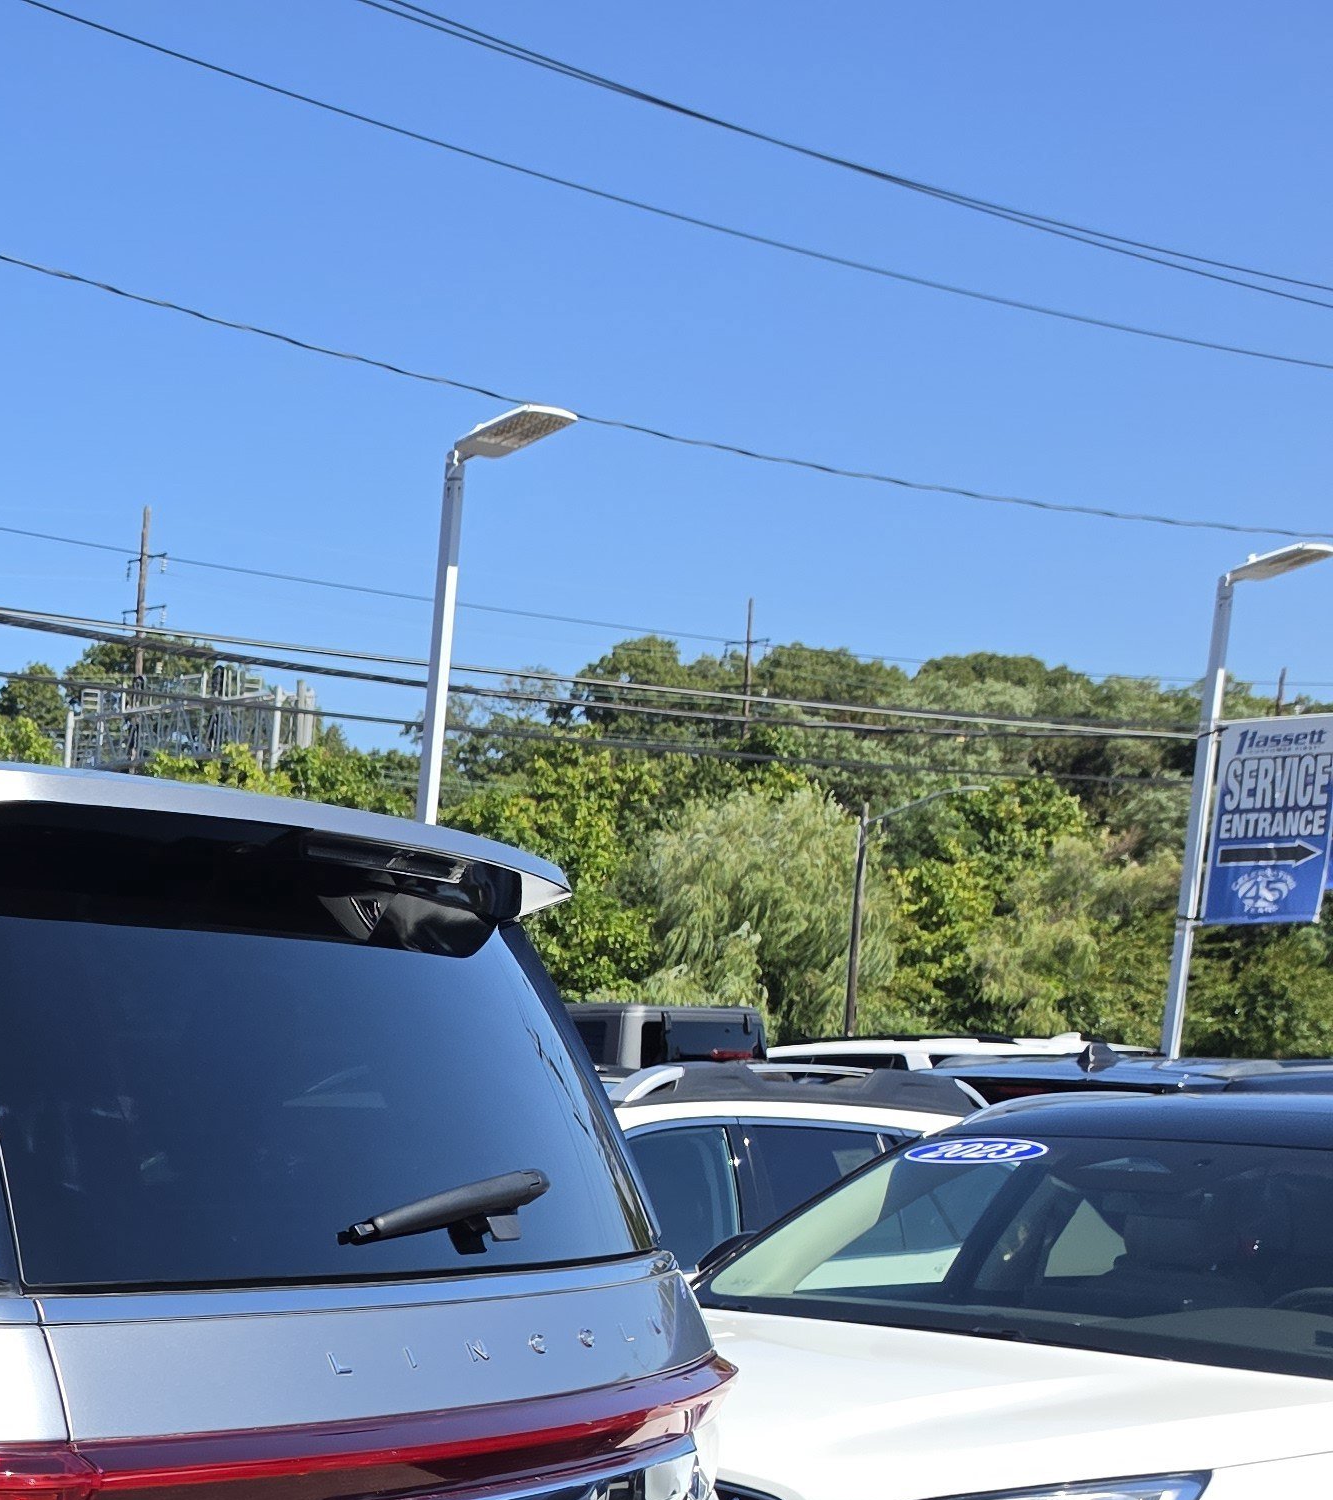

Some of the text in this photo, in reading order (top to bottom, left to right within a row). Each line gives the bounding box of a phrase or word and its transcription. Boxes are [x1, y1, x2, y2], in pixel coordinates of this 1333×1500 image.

[1223, 754, 1331, 811] SERVICE
[1218, 809, 1327, 839] ENTRANCE
[918, 1143, 1032, 1159] 2023
